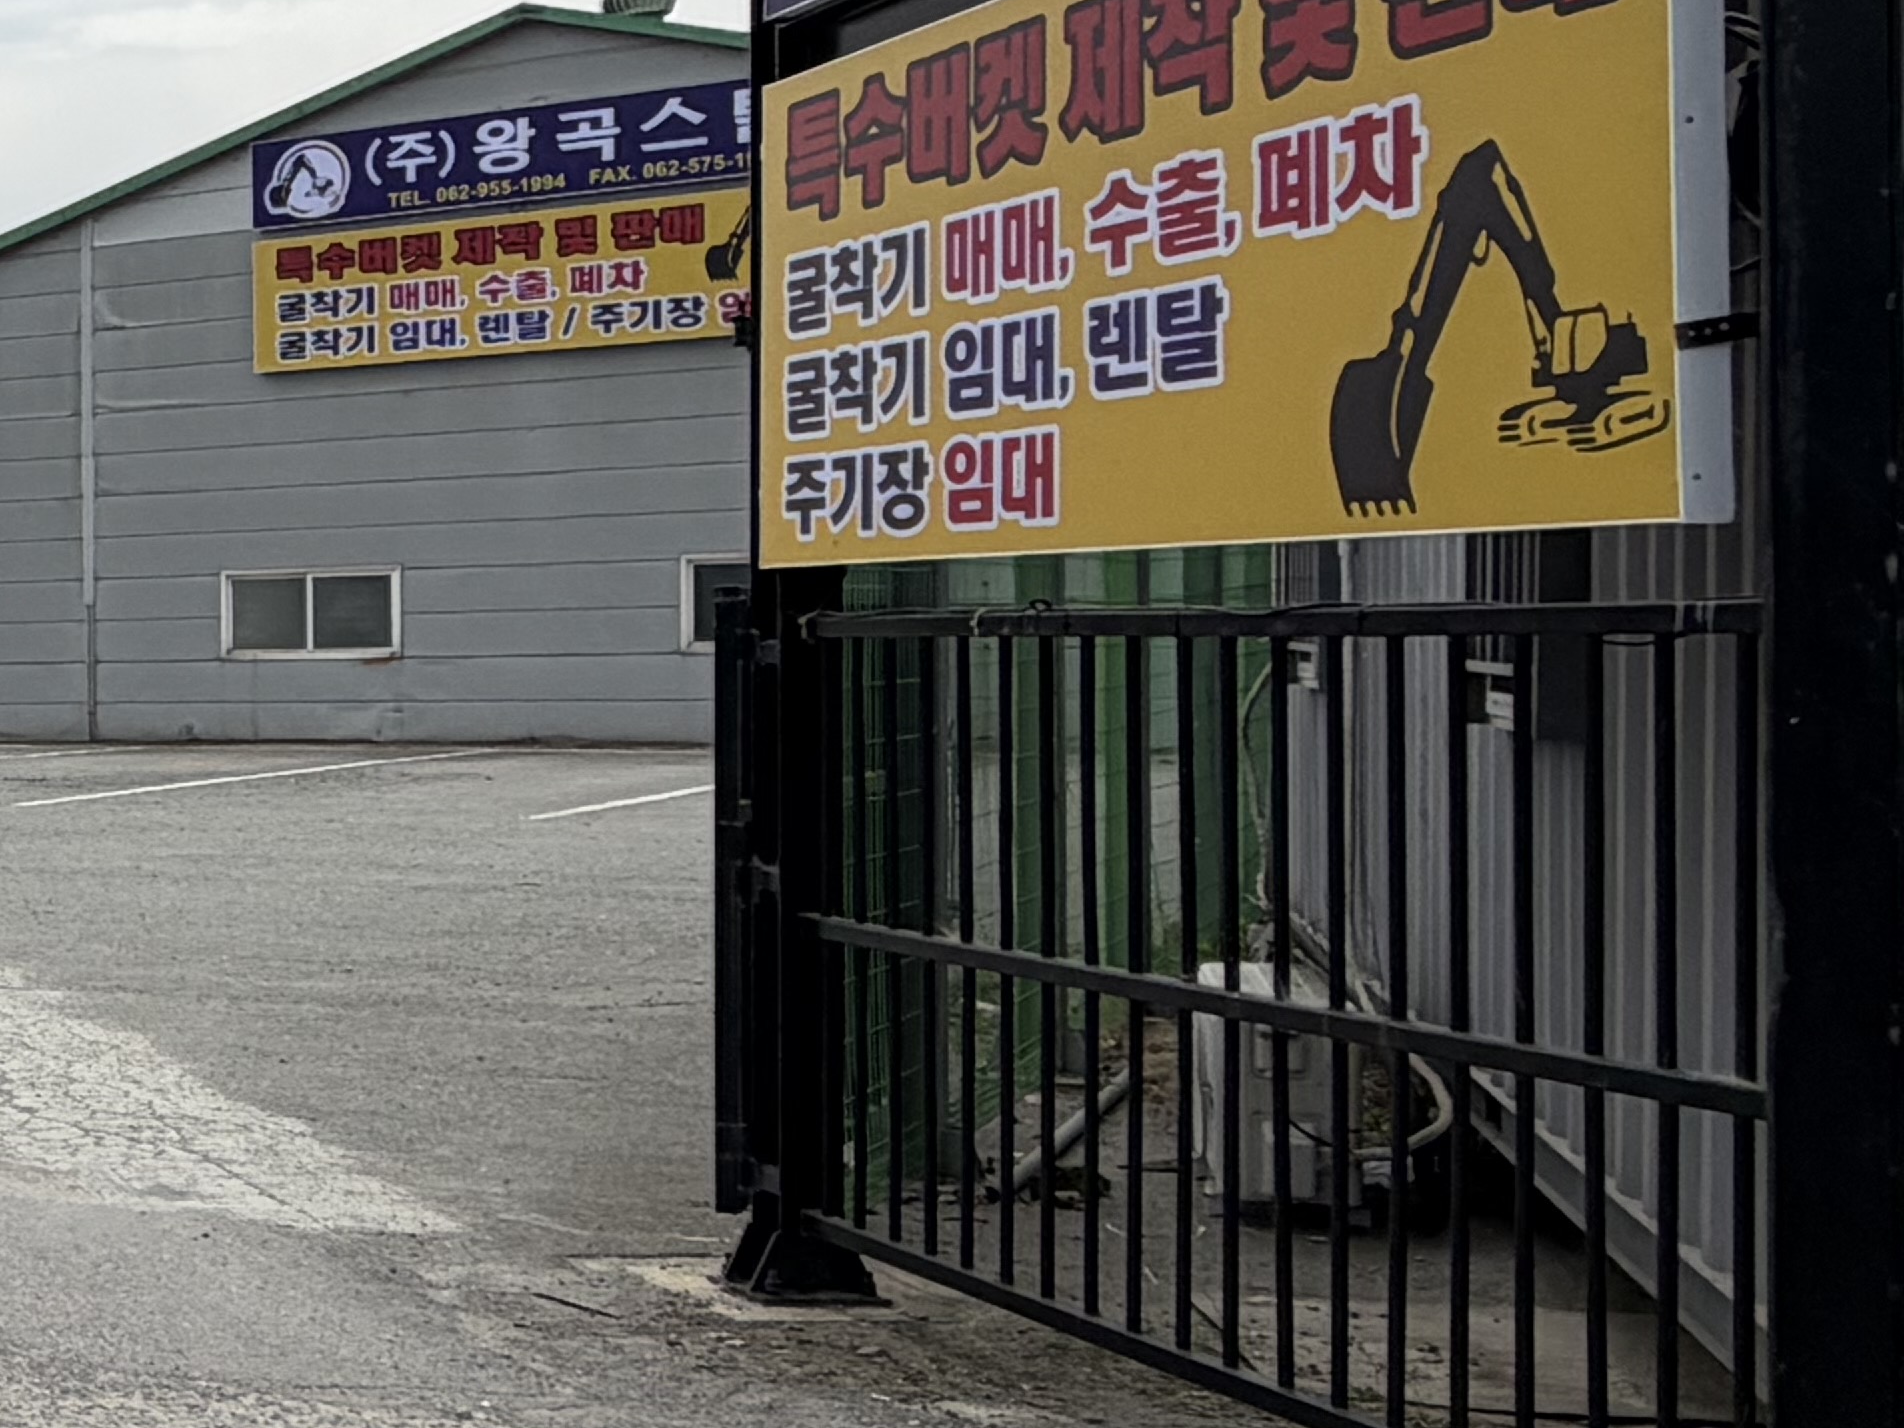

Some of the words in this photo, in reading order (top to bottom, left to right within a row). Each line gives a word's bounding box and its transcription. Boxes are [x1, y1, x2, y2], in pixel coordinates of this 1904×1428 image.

[365, 88, 750, 186] (주)왕곡스
[784, 14, 1047, 220] 특수버켓
[388, 189, 430, 208] TEL.
[436, 173, 566, 204] 062-955-1994
[588, 164, 638, 185] FAX.
[788, 223, 926, 331] 굴착기
[946, 196, 1070, 296] 매매,
[1089, 158, 1235, 272] 수출,
[1257, 104, 1422, 232] 폐차
[275, 231, 442, 283] 특수버켓
[452, 221, 544, 265] 제작
[555, 215, 598, 258] 및
[610, 203, 705, 251] 판매
[278, 285, 375, 323] 굴착기
[390, 278, 466, 311] 매매,
[278, 324, 375, 361] 굴착기
[390, 318, 466, 350] 임대,
[479, 310, 550, 342] 렌탈
[592, 296, 706, 334] 주기장
[788, 324, 926, 434] 굴착기
[946, 315, 1070, 409] 임대,
[1089, 285, 1221, 390] 렌탈
[786, 449, 927, 535] 주기장
[946, 433, 1055, 523] 임대
